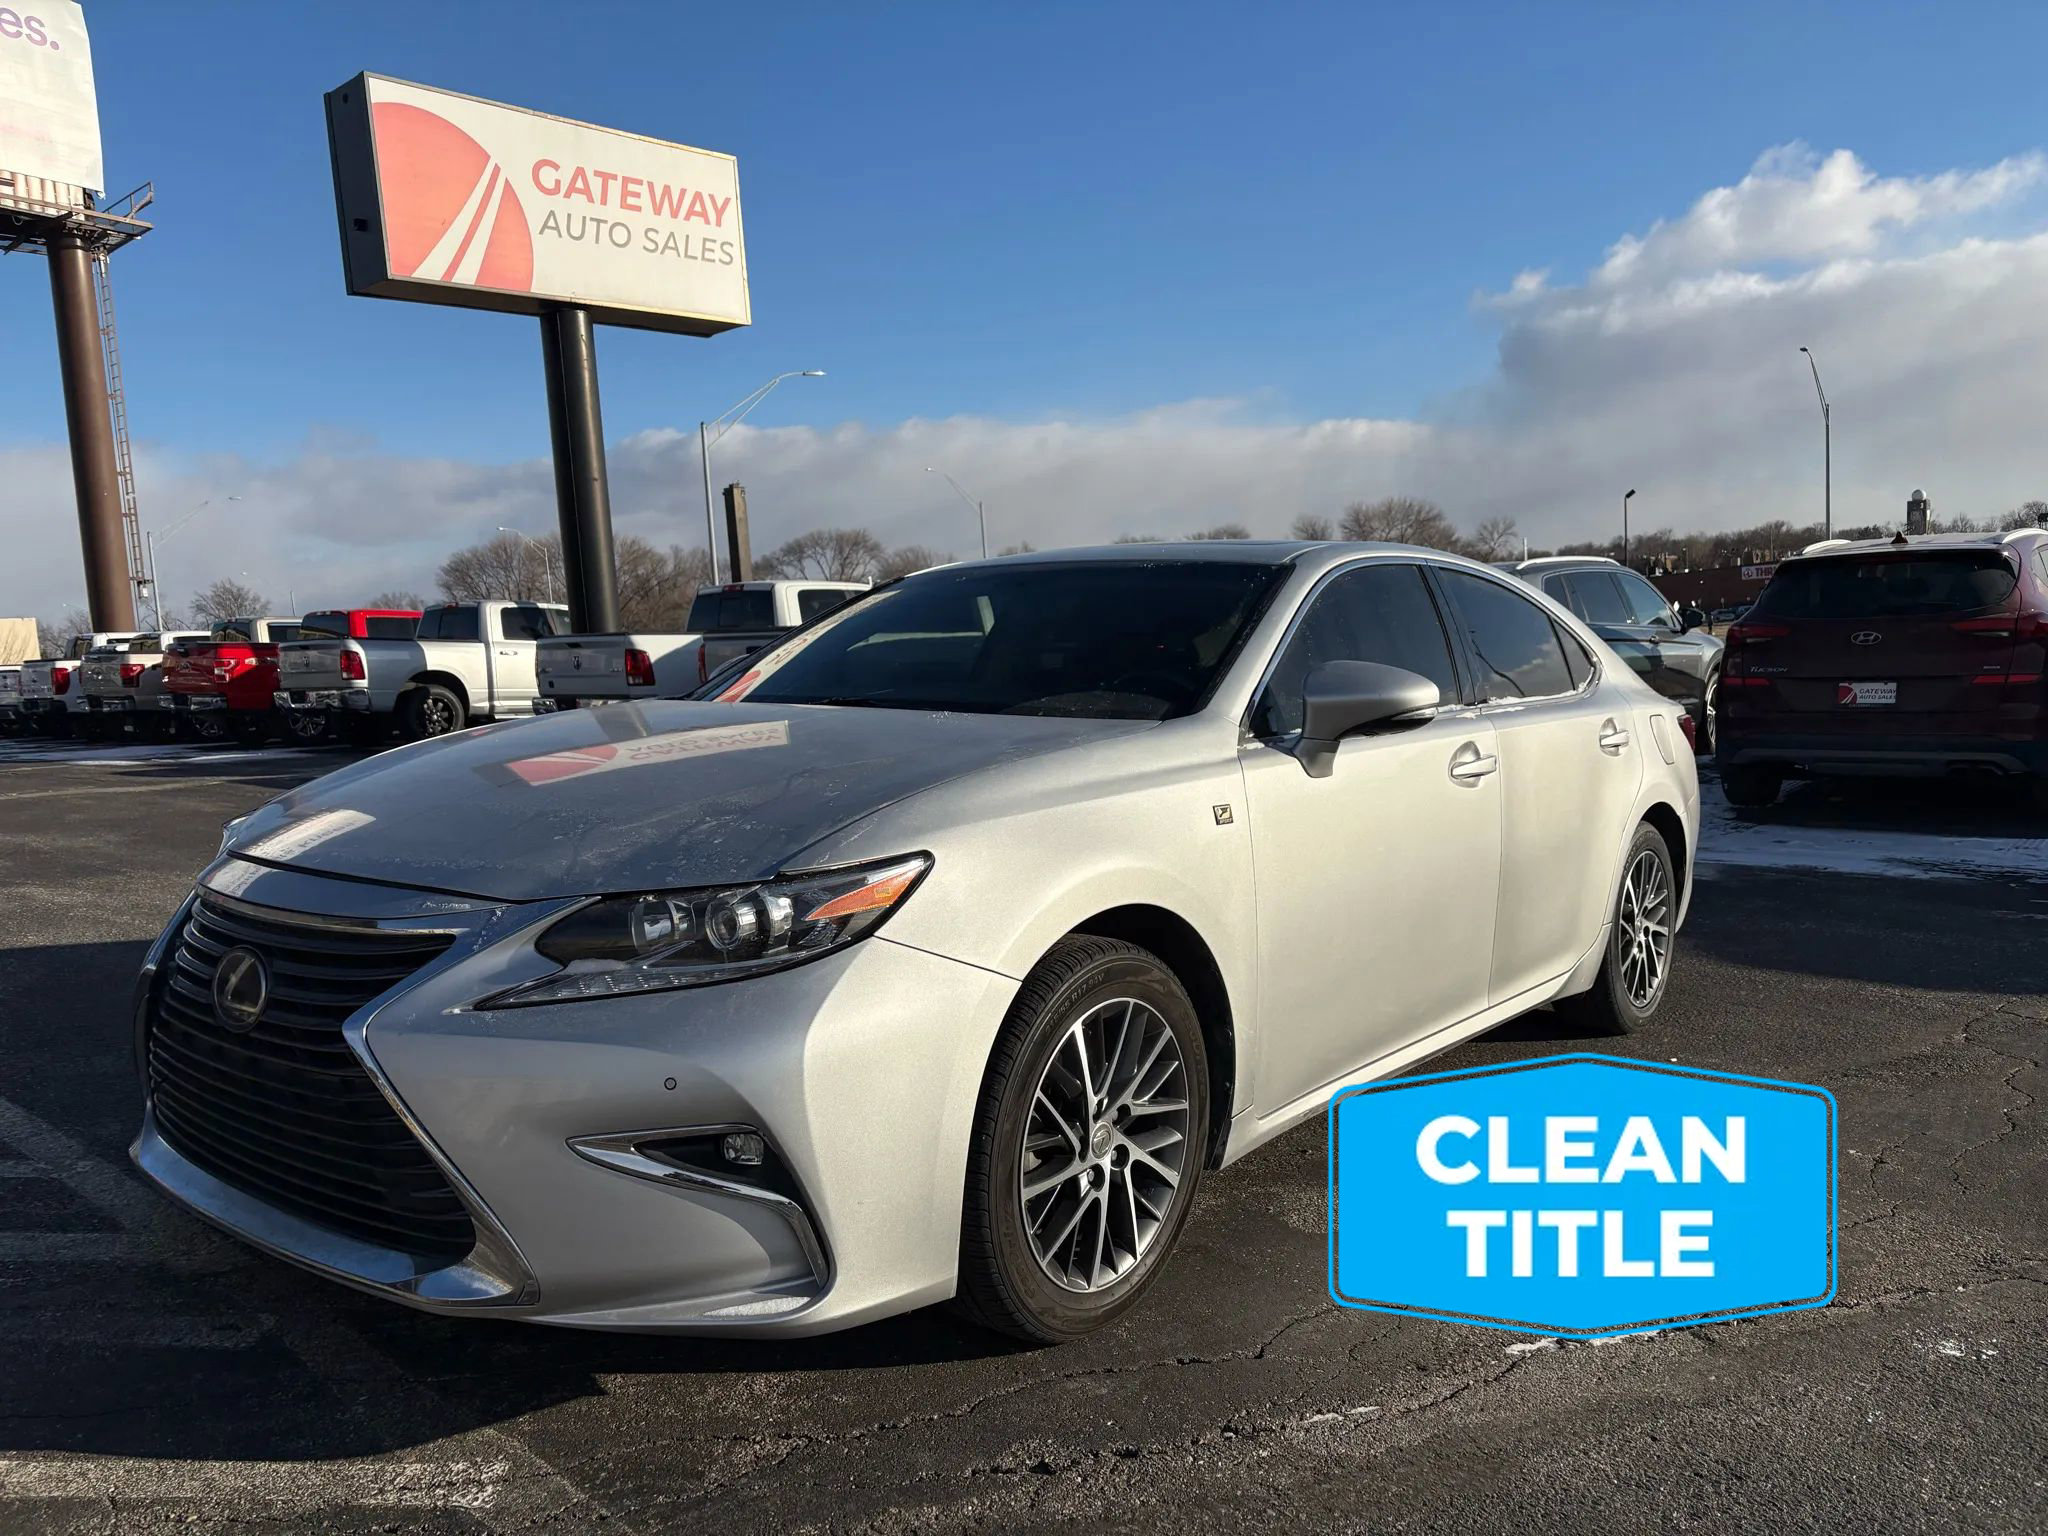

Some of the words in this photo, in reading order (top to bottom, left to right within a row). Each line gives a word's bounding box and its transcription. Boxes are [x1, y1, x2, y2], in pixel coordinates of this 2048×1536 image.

[0, 7, 59, 50] es.
[532, 159, 731, 228] GATEWAY
[539, 209, 632, 248] AUTO
[642, 228, 734, 265] SALES
